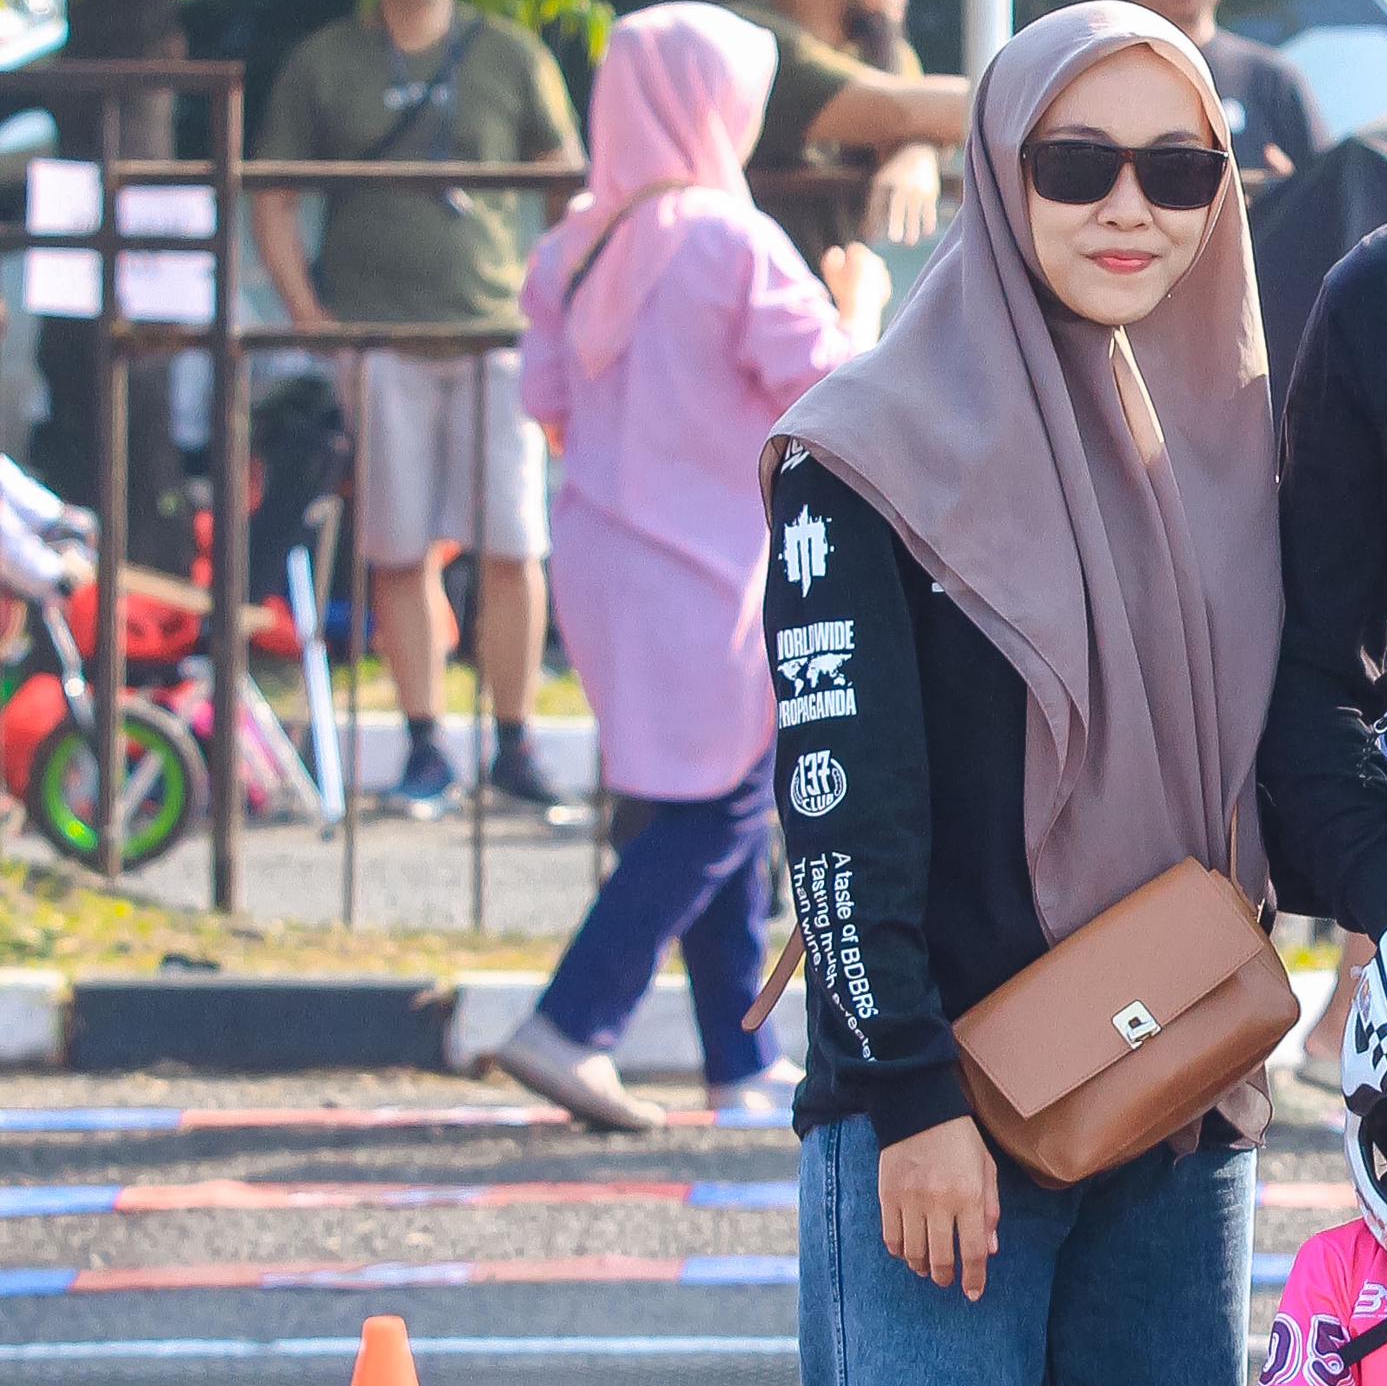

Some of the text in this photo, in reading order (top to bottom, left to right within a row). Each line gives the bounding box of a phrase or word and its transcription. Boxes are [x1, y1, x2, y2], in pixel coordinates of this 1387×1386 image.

[798, 750, 831, 798] 137
[802, 791, 834, 811] CLUB
[832, 851, 851, 868] A
[793, 857, 822, 972] Than wine.
[834, 871, 854, 920] taste
[810, 854, 830, 928] Tasting
[820, 931, 837, 989] much
[841, 924, 859, 943] of
